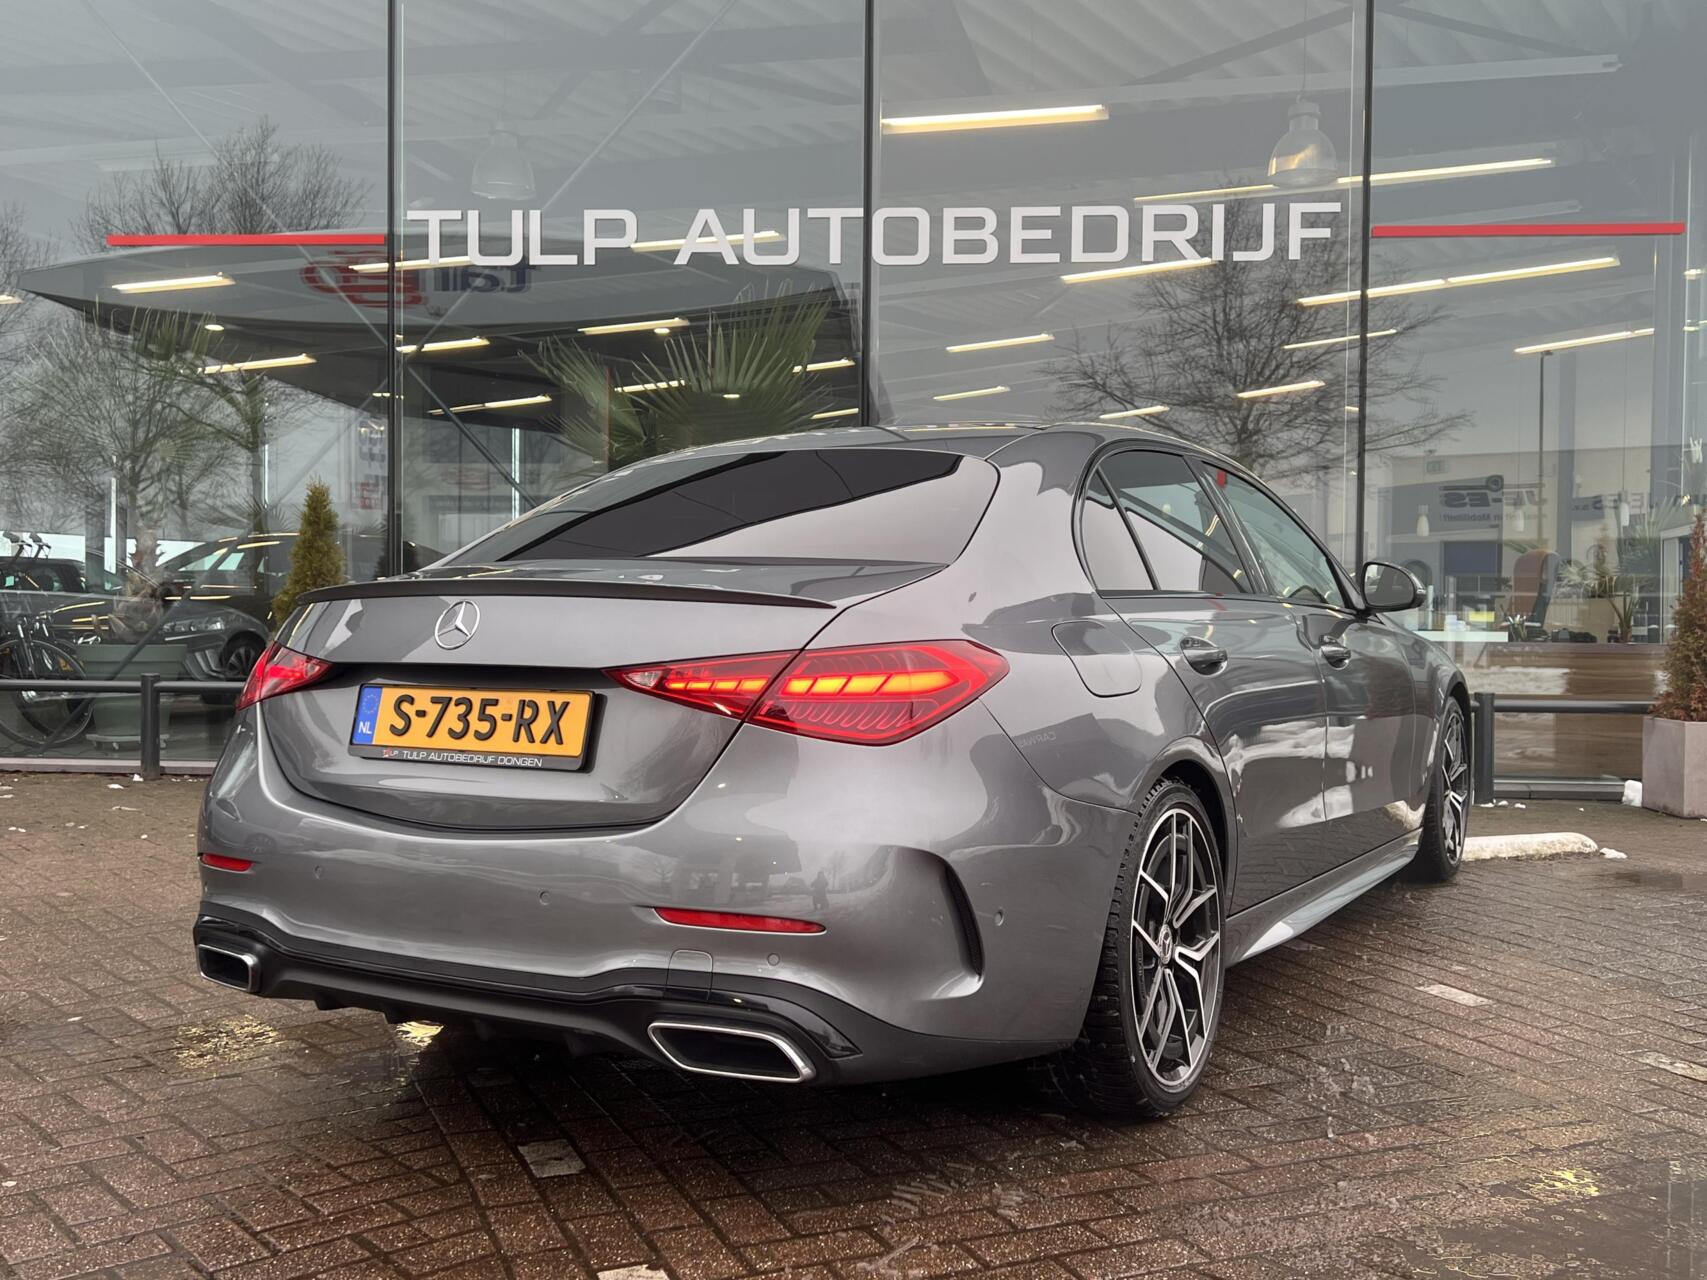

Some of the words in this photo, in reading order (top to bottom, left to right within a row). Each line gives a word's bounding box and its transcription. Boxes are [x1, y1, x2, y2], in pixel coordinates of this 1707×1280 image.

[406, 208, 639, 267] TULP
[673, 202, 1342, 266] AUTOBEDRIJF
[358, 721, 373, 735] NL
[389, 694, 571, 745] S-735-RX
[403, 750, 427, 760] TULP
[428, 751, 496, 764] AUTOBEDRIJF
[497, 755, 542, 767] DONGEN
